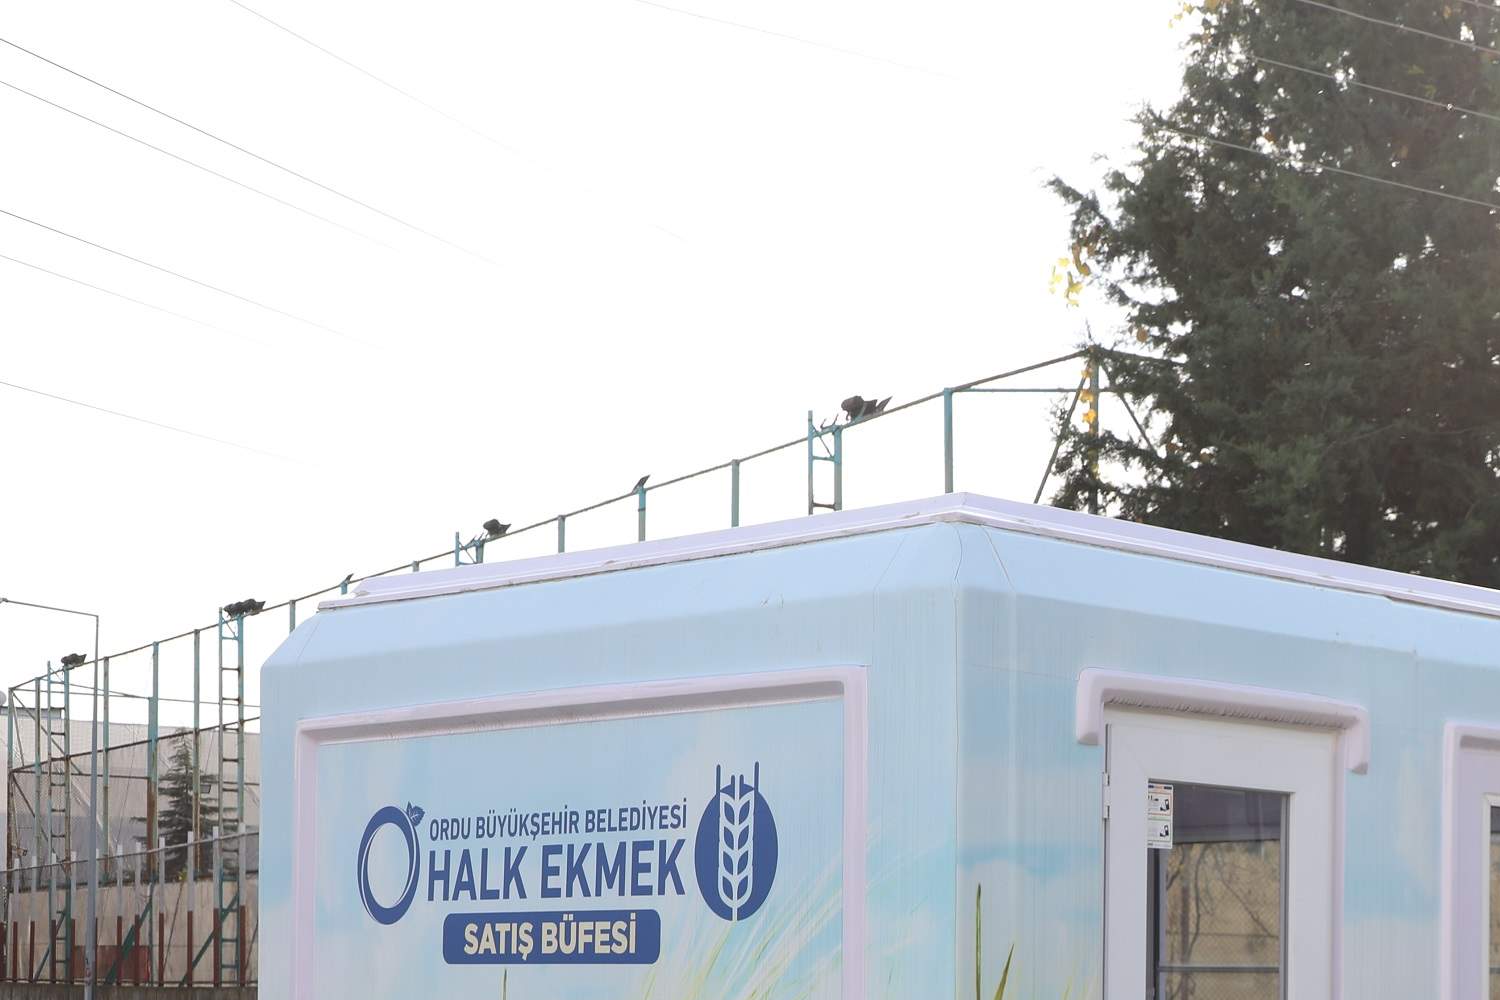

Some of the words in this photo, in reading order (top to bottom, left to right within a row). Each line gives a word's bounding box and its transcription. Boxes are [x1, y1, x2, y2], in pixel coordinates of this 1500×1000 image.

[429, 815, 471, 842] ORDU
[475, 803, 579, 841] BÜYÜKŞEHİR
[585, 798, 687, 833] BELEDİYESİ
[427, 845, 528, 901] HALK
[540, 838, 687, 899] EKMEK
[464, 918, 534, 961] SATIŞ
[541, 912, 636, 955] BÜFESİ
